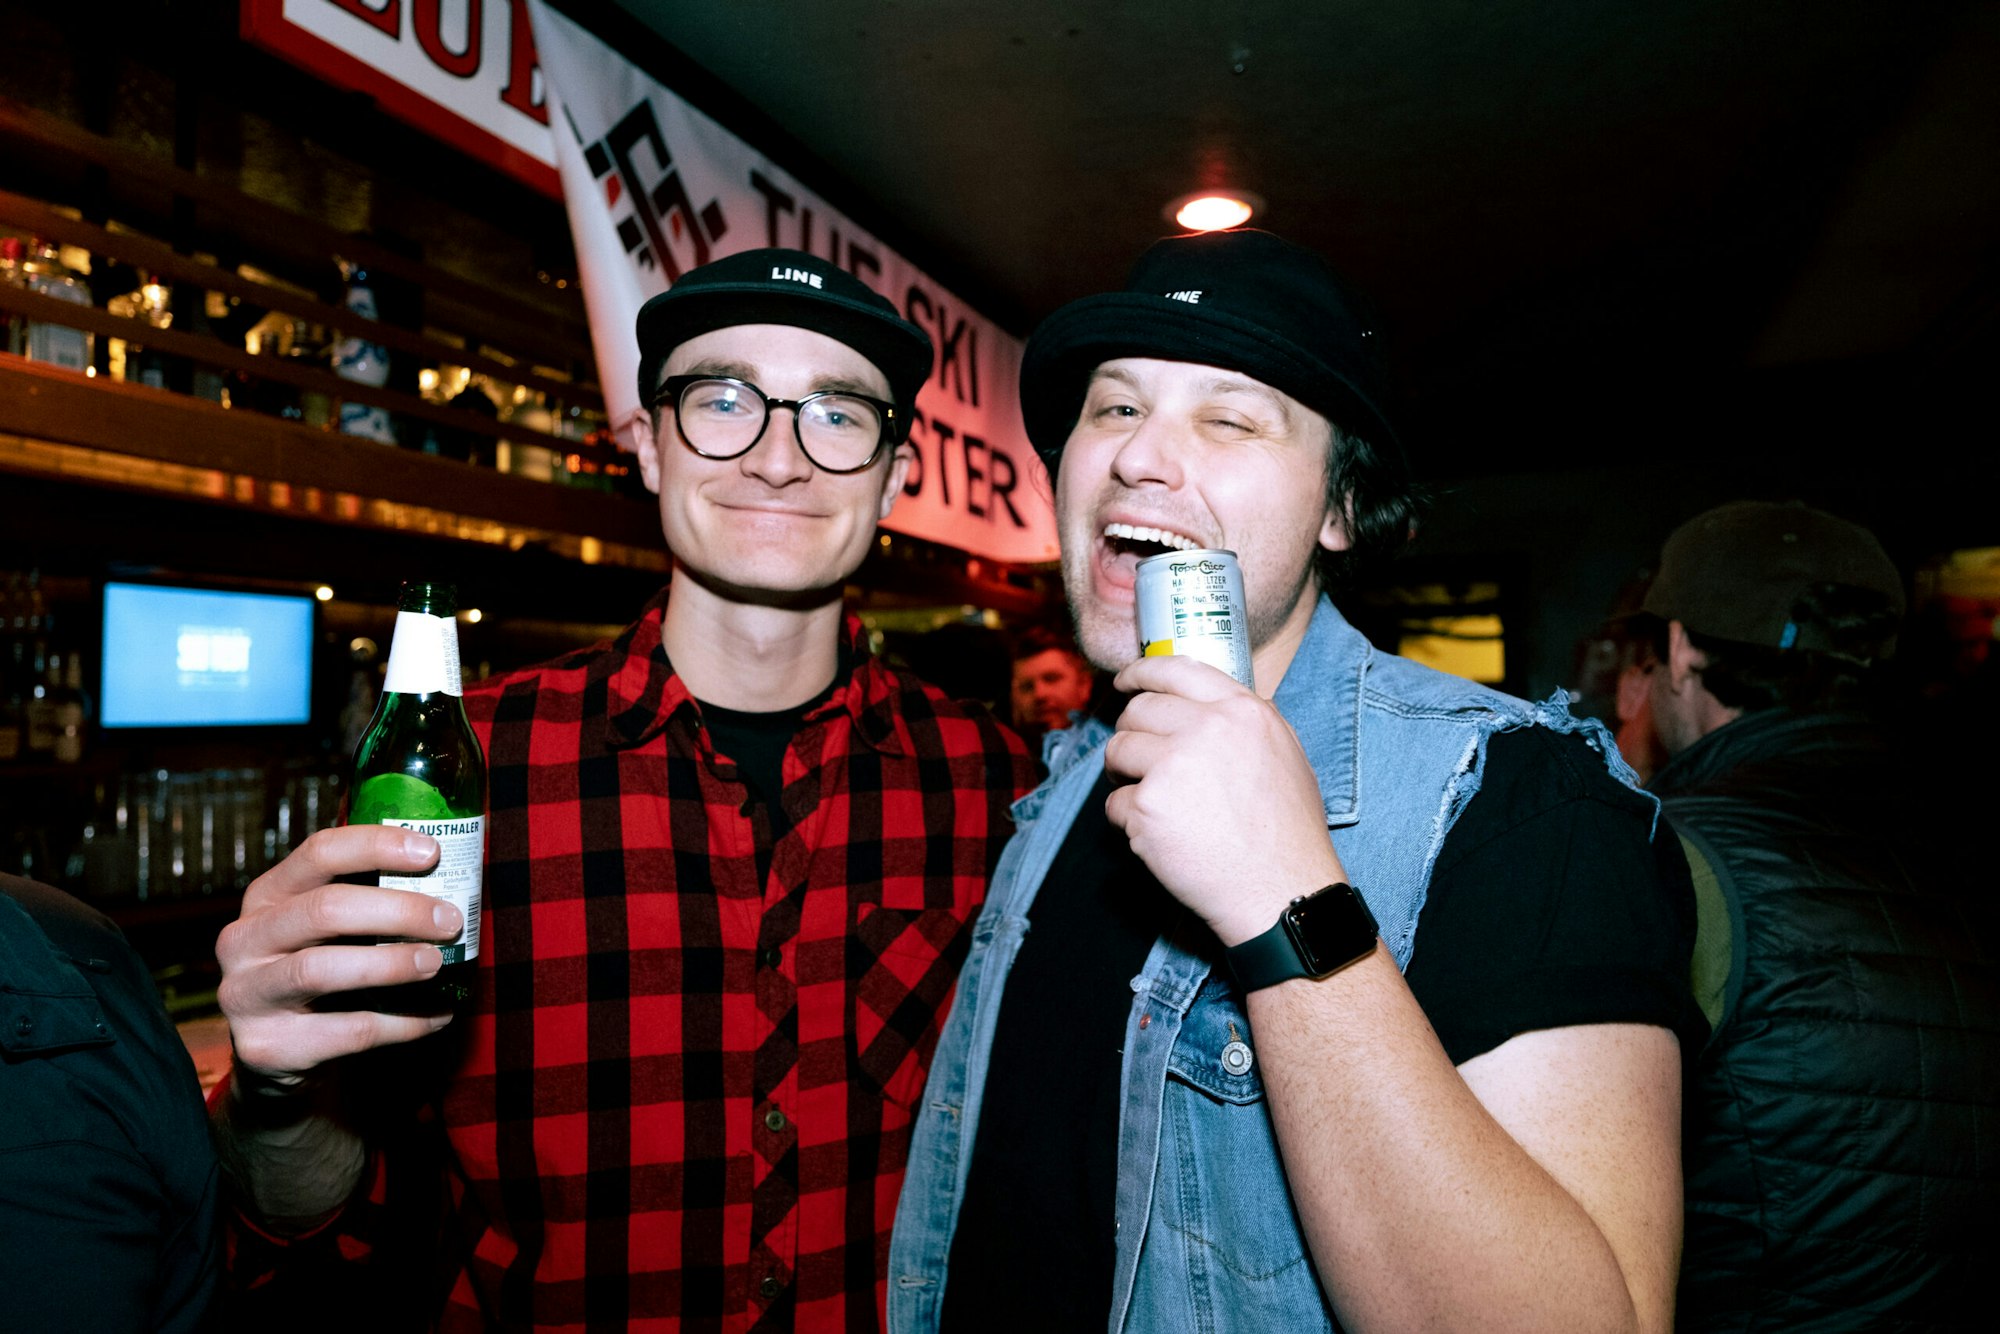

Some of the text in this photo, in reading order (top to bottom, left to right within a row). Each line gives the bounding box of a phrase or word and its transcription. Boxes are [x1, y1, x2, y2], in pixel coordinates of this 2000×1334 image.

[771, 266, 823, 290] LINE
[906, 285, 978, 407] SKI
[903, 407, 1026, 528] STER
[1169, 560, 1226, 576] Topo Chico
[1197, 576, 1226, 586] LTZER
[1210, 593, 1229, 602] Facts
[1214, 618, 1232, 632] 100
